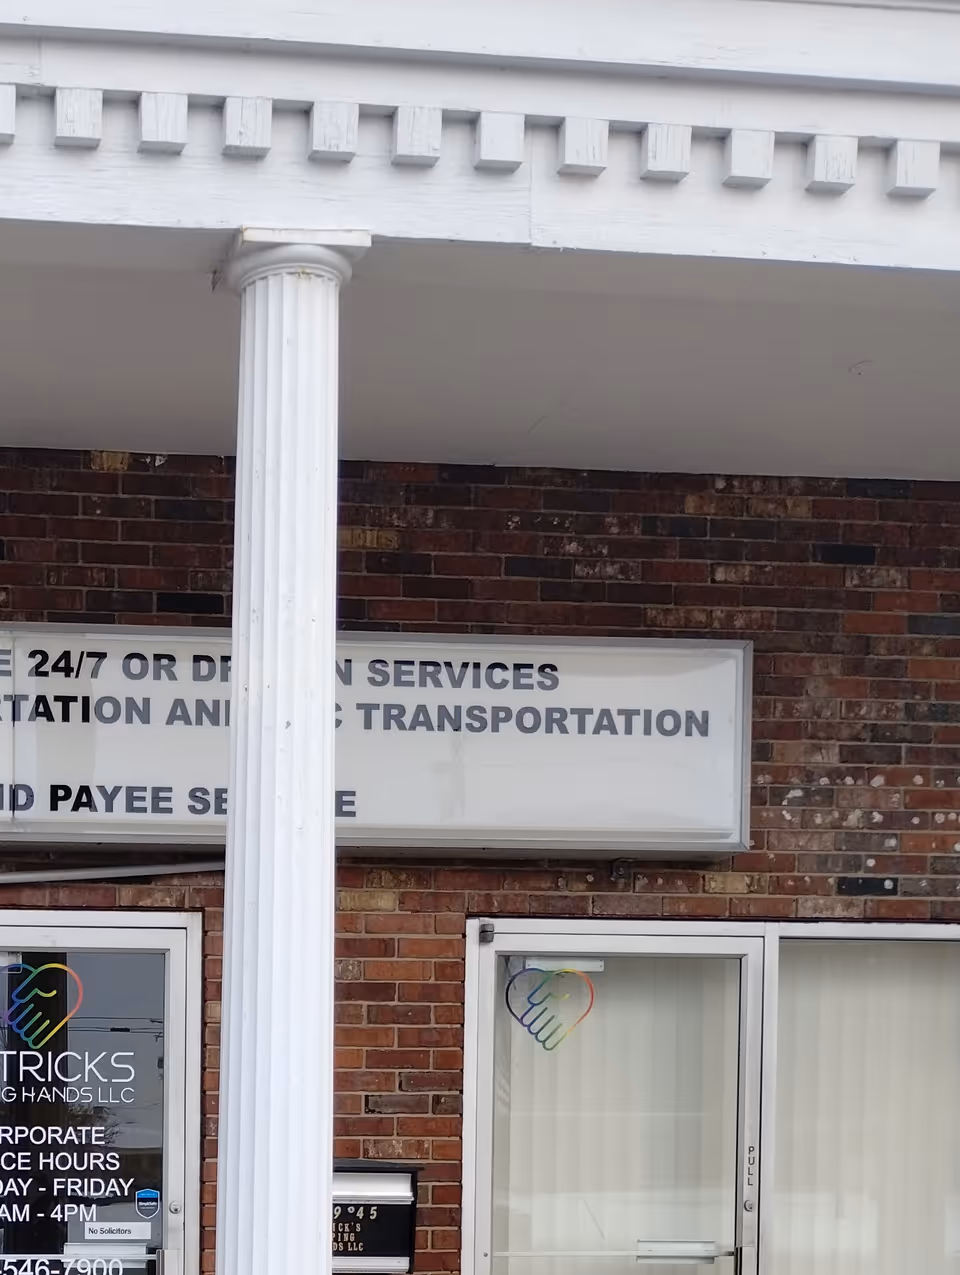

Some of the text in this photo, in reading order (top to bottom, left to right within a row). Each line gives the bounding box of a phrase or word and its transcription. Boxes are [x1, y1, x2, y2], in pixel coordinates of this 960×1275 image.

[27, 649, 107, 679] 24/7
[122, 652, 177, 681] OR
[367, 658, 560, 690] SERVICES
[356, 703, 709, 737] TRANSPORTATION
[49, 784, 173, 814] PAYEE
[22, 1087, 92, 1102] HANDS
[98, 1087, 135, 1103] LLC
[39, 1152, 120, 1170] HOURS
[747, 1146, 755, 1186] PULL
[53, 1178, 135, 1196] FRIDAY
[50, 1204, 97, 1222] 4PM
[88, 1227, 132, 1235] No Solicitors
[348, 1242, 364, 1252] LLC
